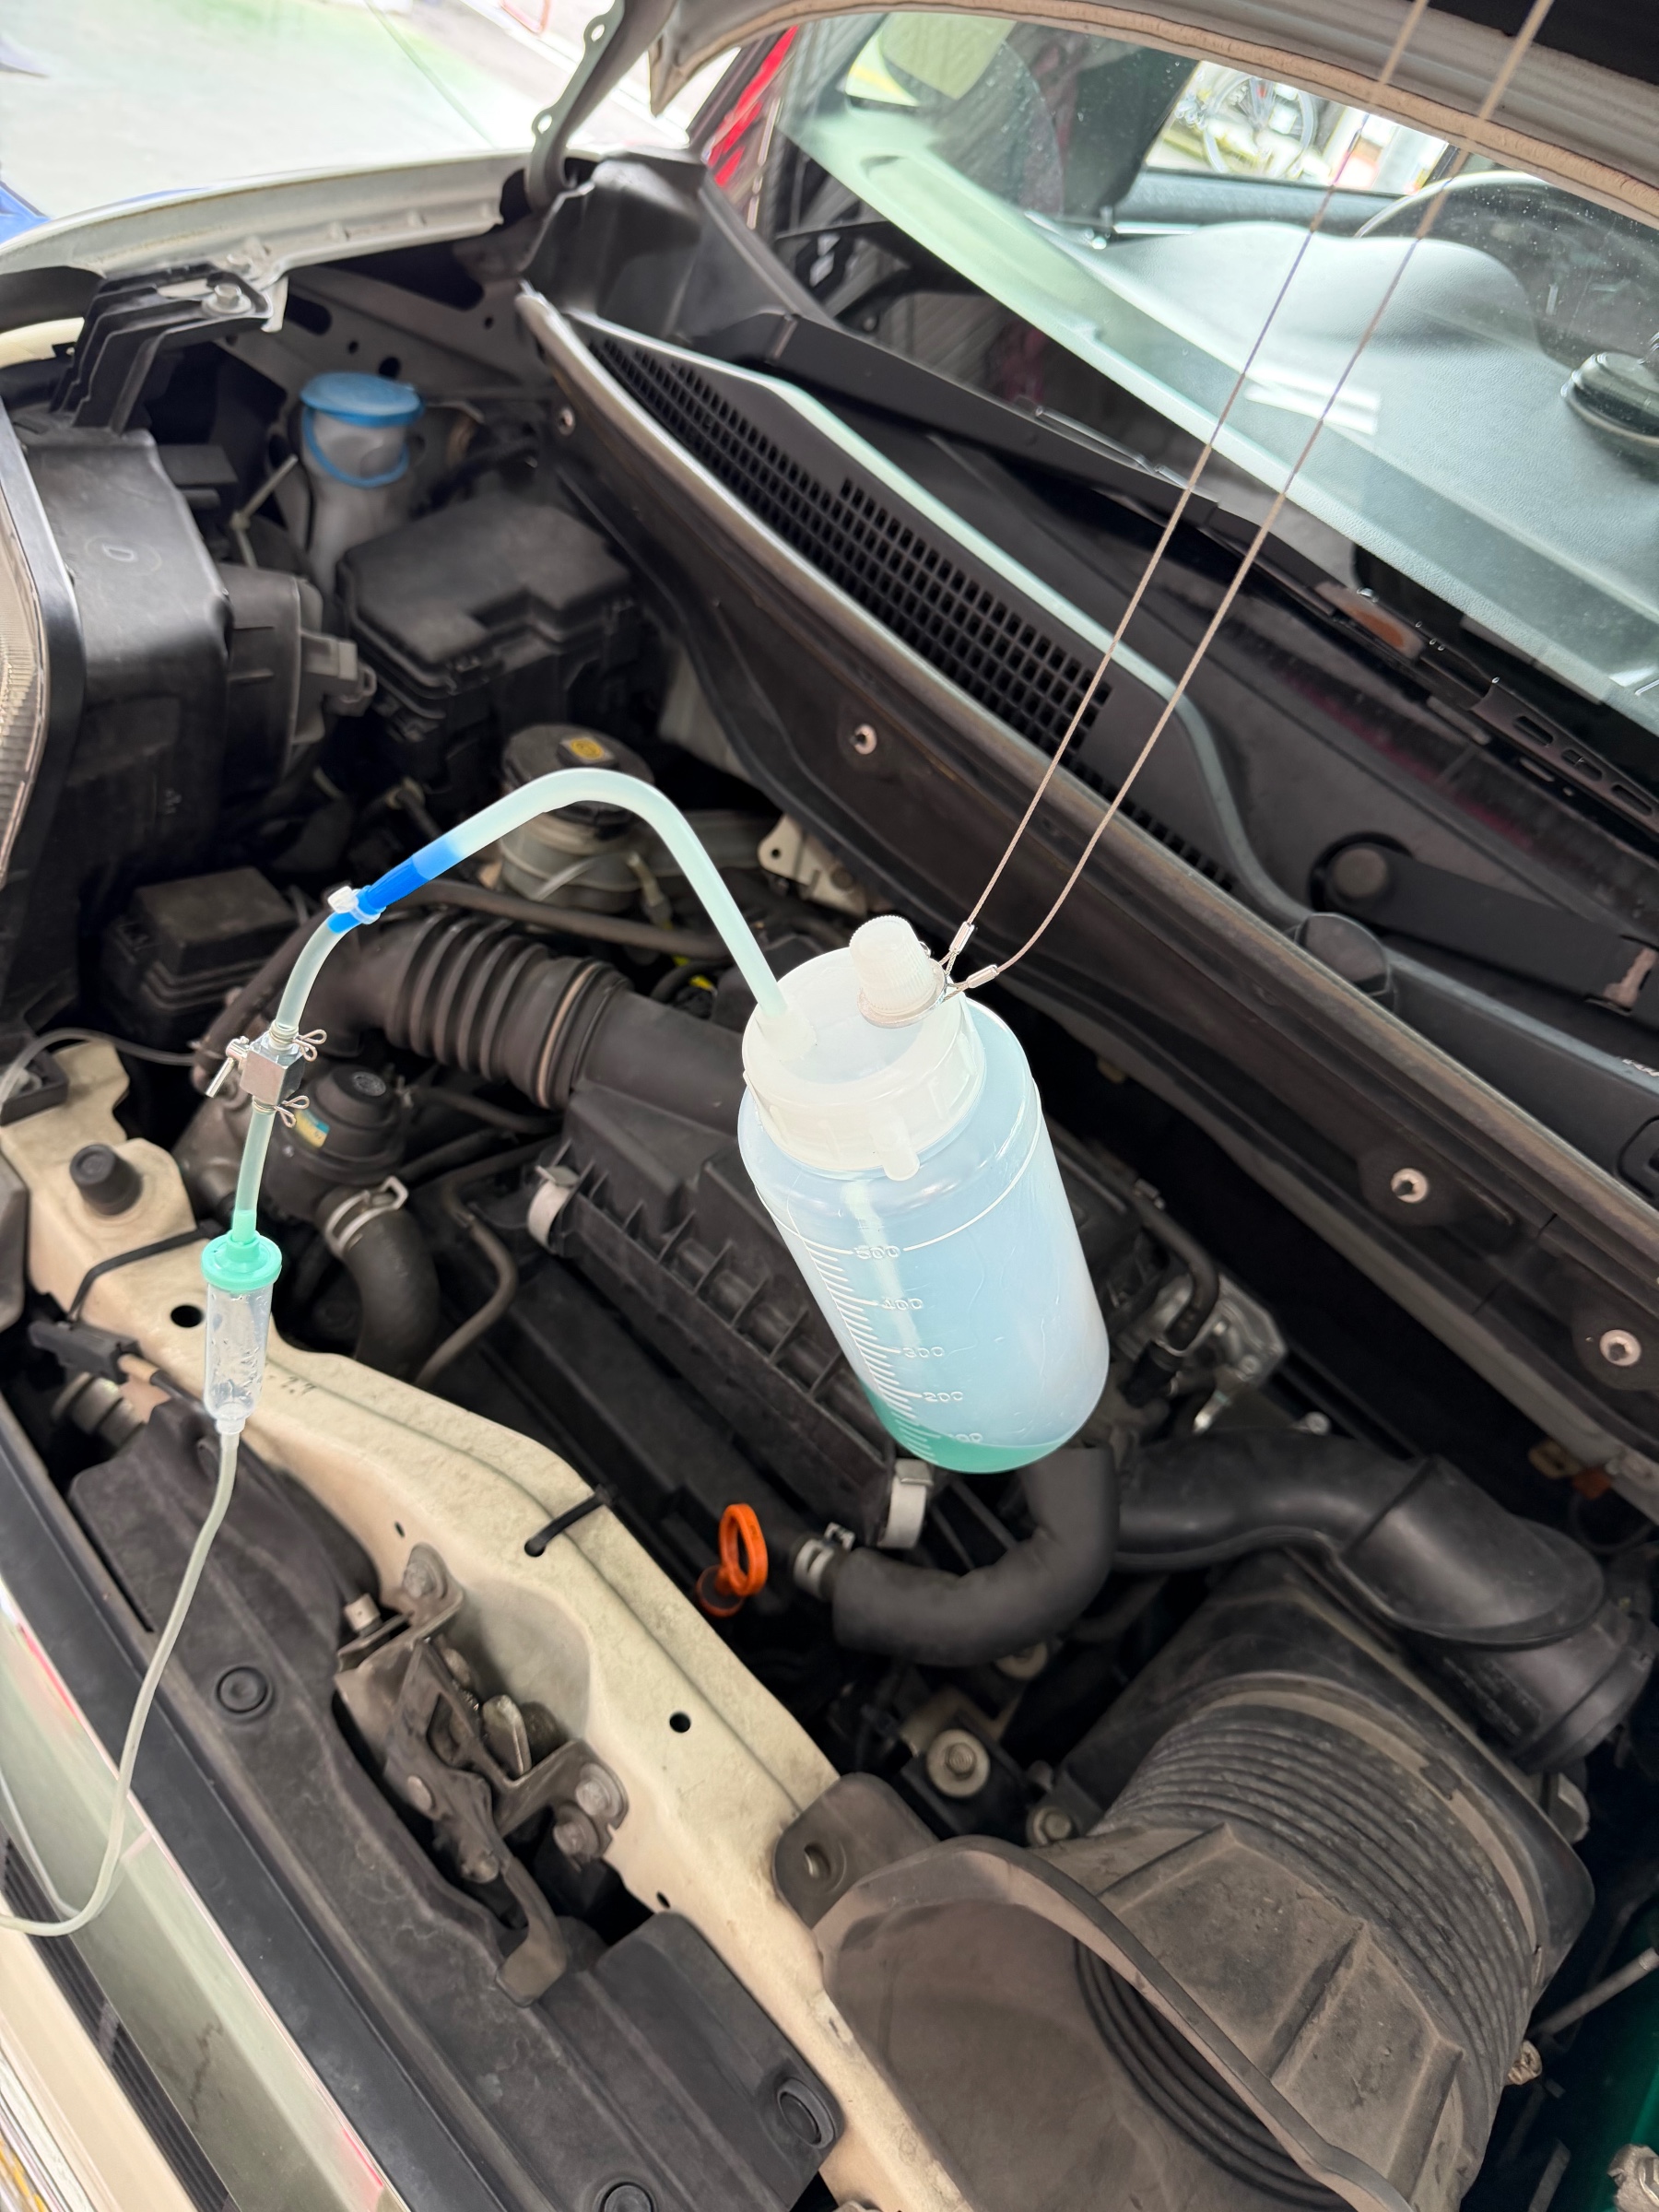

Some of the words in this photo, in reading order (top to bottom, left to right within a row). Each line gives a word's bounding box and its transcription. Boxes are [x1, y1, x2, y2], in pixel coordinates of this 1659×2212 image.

[855, 1245, 900, 1259] 500
[882, 1298, 923, 1310] 400
[902, 1347, 945, 1358] 300
[923, 1391, 964, 1403] 200
